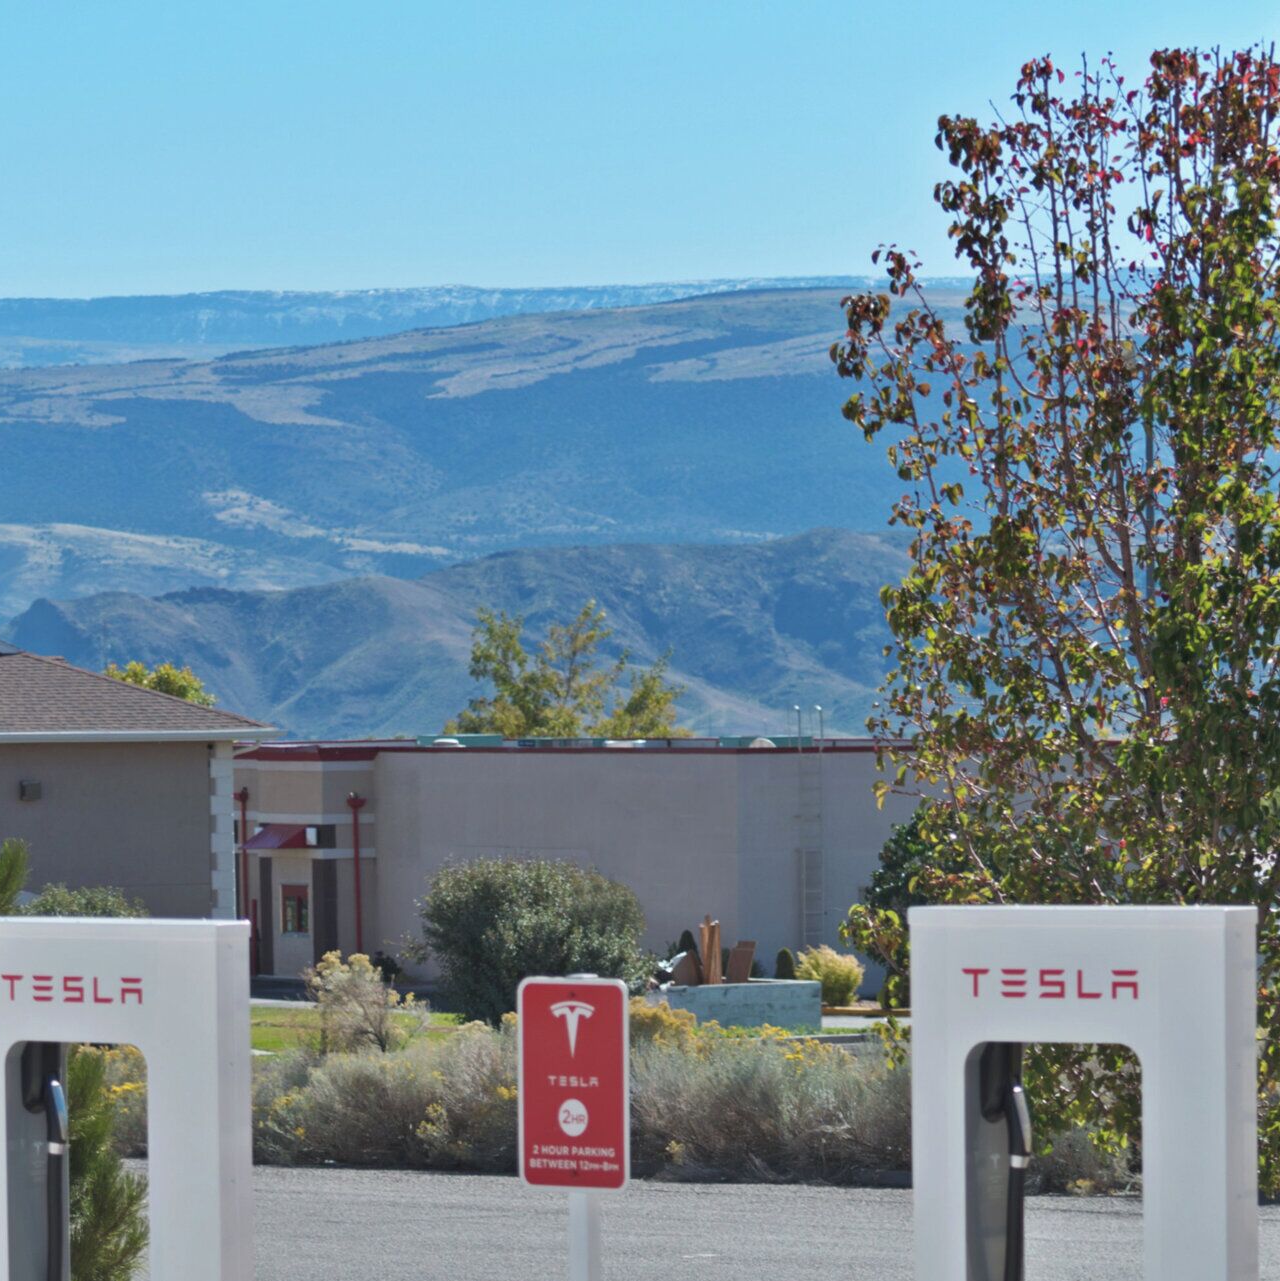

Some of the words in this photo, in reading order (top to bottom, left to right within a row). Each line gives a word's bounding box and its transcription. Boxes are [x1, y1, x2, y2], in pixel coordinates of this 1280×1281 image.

[1, 974, 143, 1004] TESLA
[961, 968, 1139, 1000] TESLA
[548, 1075, 599, 1087] TESLA
[541, 1145, 570, 1156] HOUR
[572, 1147, 615, 1158] PARKING
[529, 1158, 577, 1169] BETWEEN
